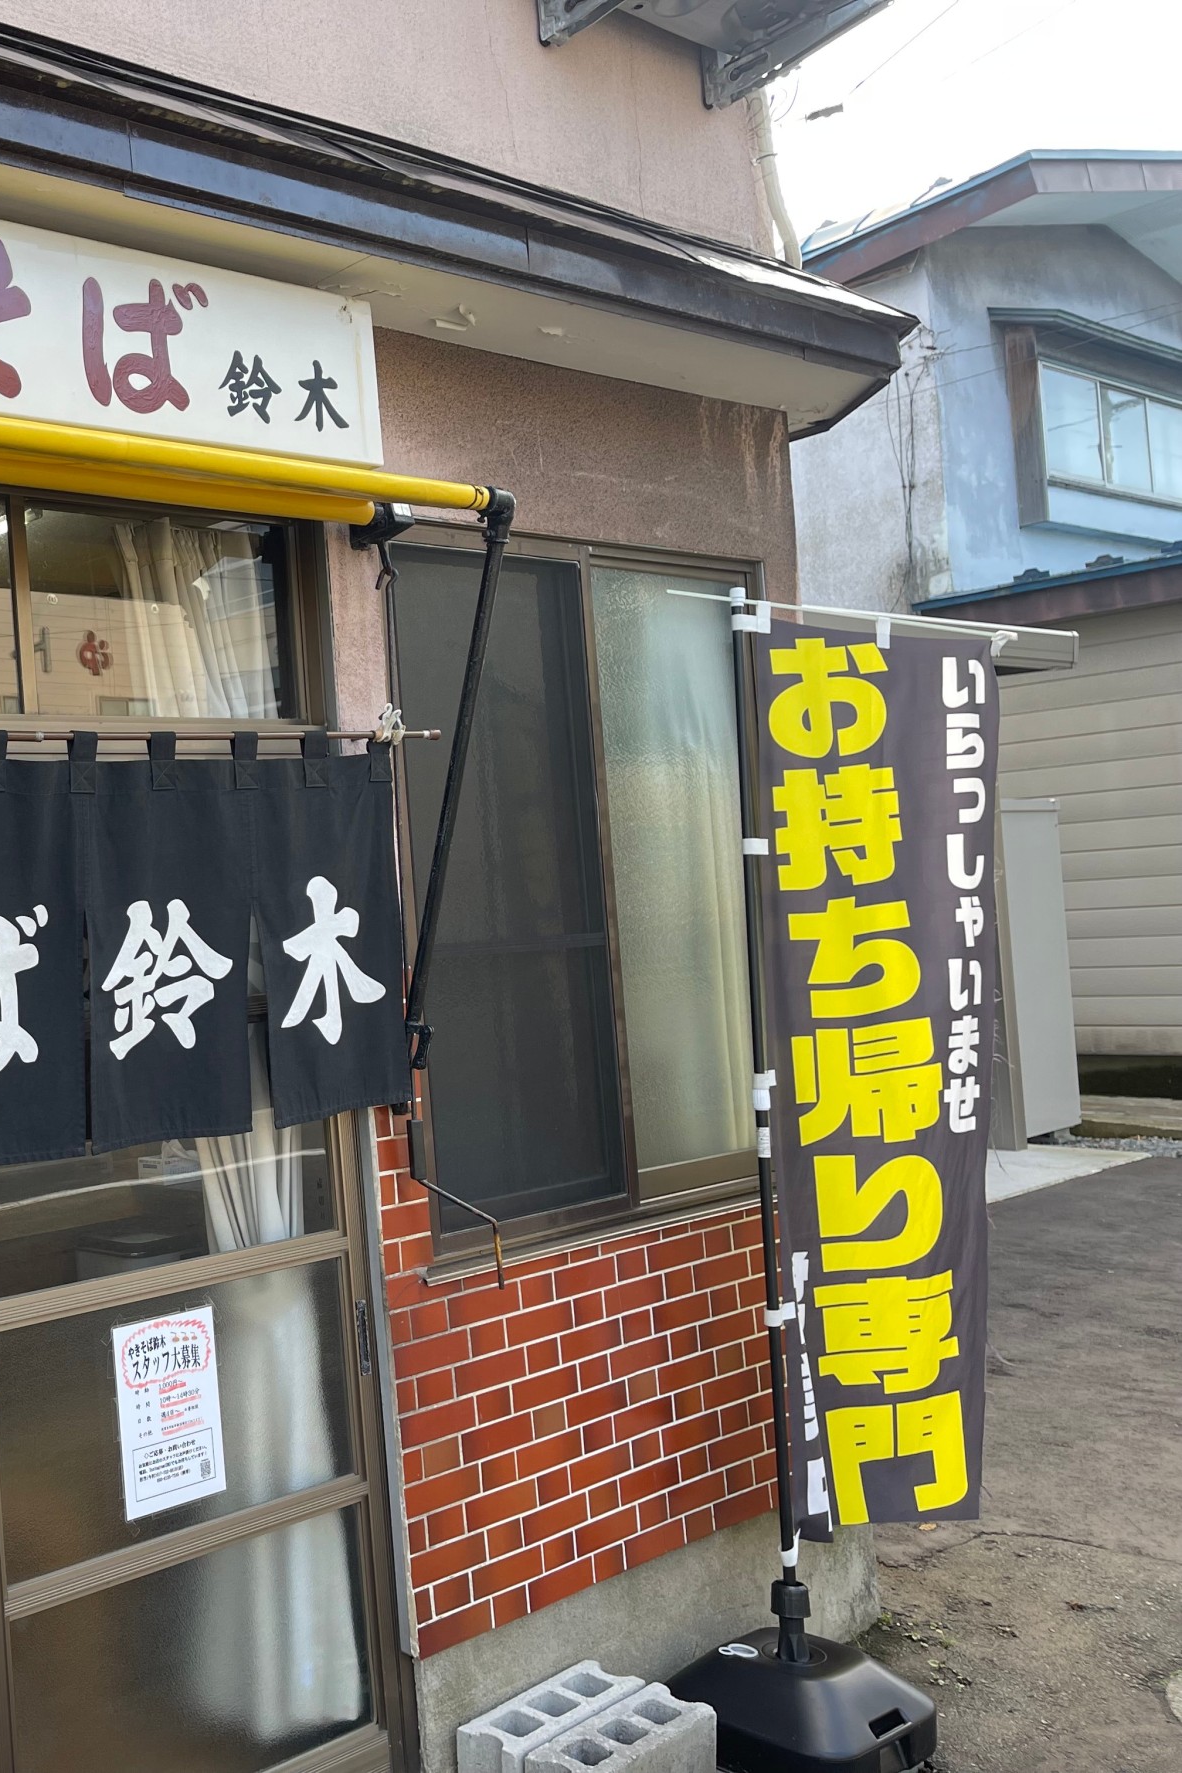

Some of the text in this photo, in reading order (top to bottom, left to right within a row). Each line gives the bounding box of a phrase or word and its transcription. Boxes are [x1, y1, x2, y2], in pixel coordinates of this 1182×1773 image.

[218, 350, 350, 432] 鈴木
[941, 656, 986, 1133] いらっしゃいませ
[768, 637, 969, 1526] お持ち帰り専門
[132, 1343, 201, 1383] スタッフ大募集
